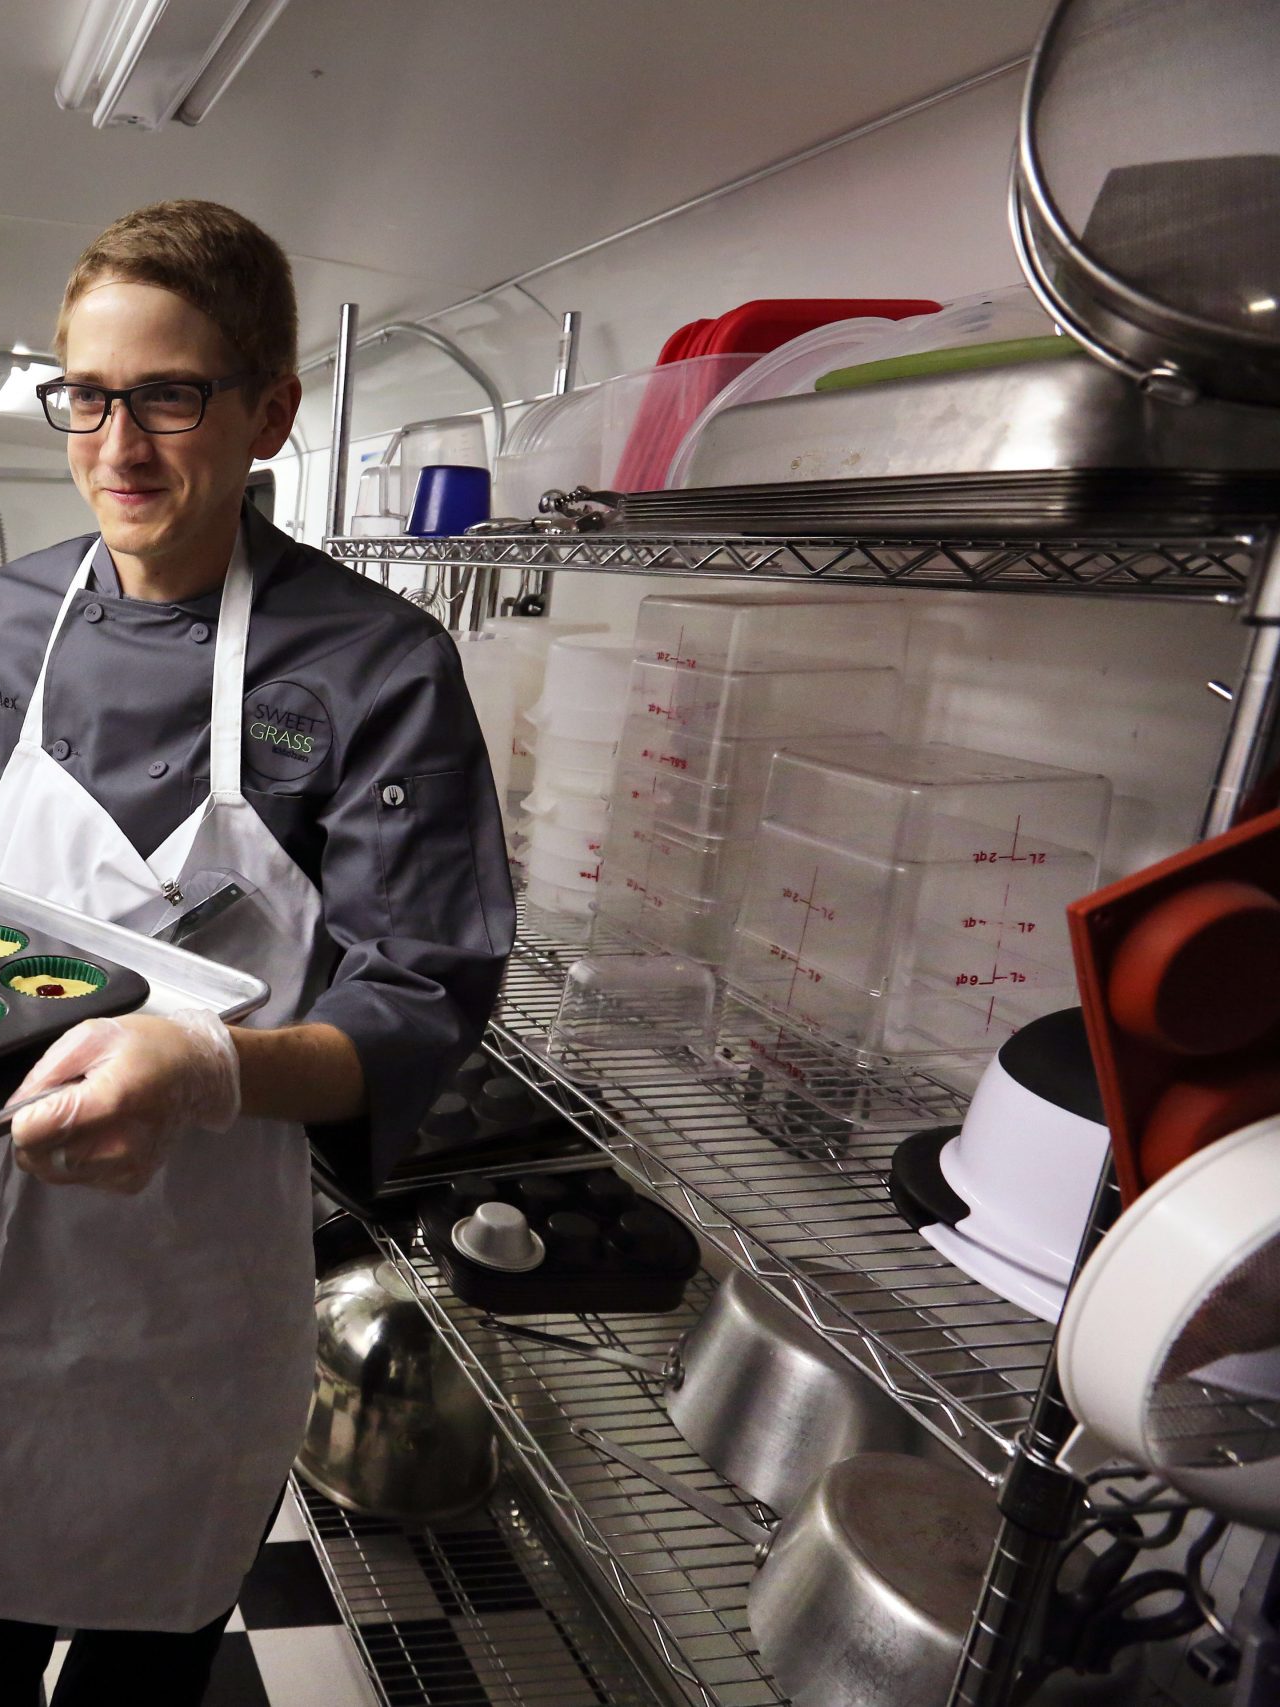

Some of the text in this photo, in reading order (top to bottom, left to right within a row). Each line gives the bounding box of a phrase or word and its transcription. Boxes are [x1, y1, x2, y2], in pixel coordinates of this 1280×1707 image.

[255, 703, 325, 733] SWEET
[250, 722, 314, 753] GRASS
[973, 851, 998, 864] 2qt
[1029, 853, 1046, 864] 2L
[1017, 922, 1036, 933] 4L
[956, 973, 979, 987] 6qt
